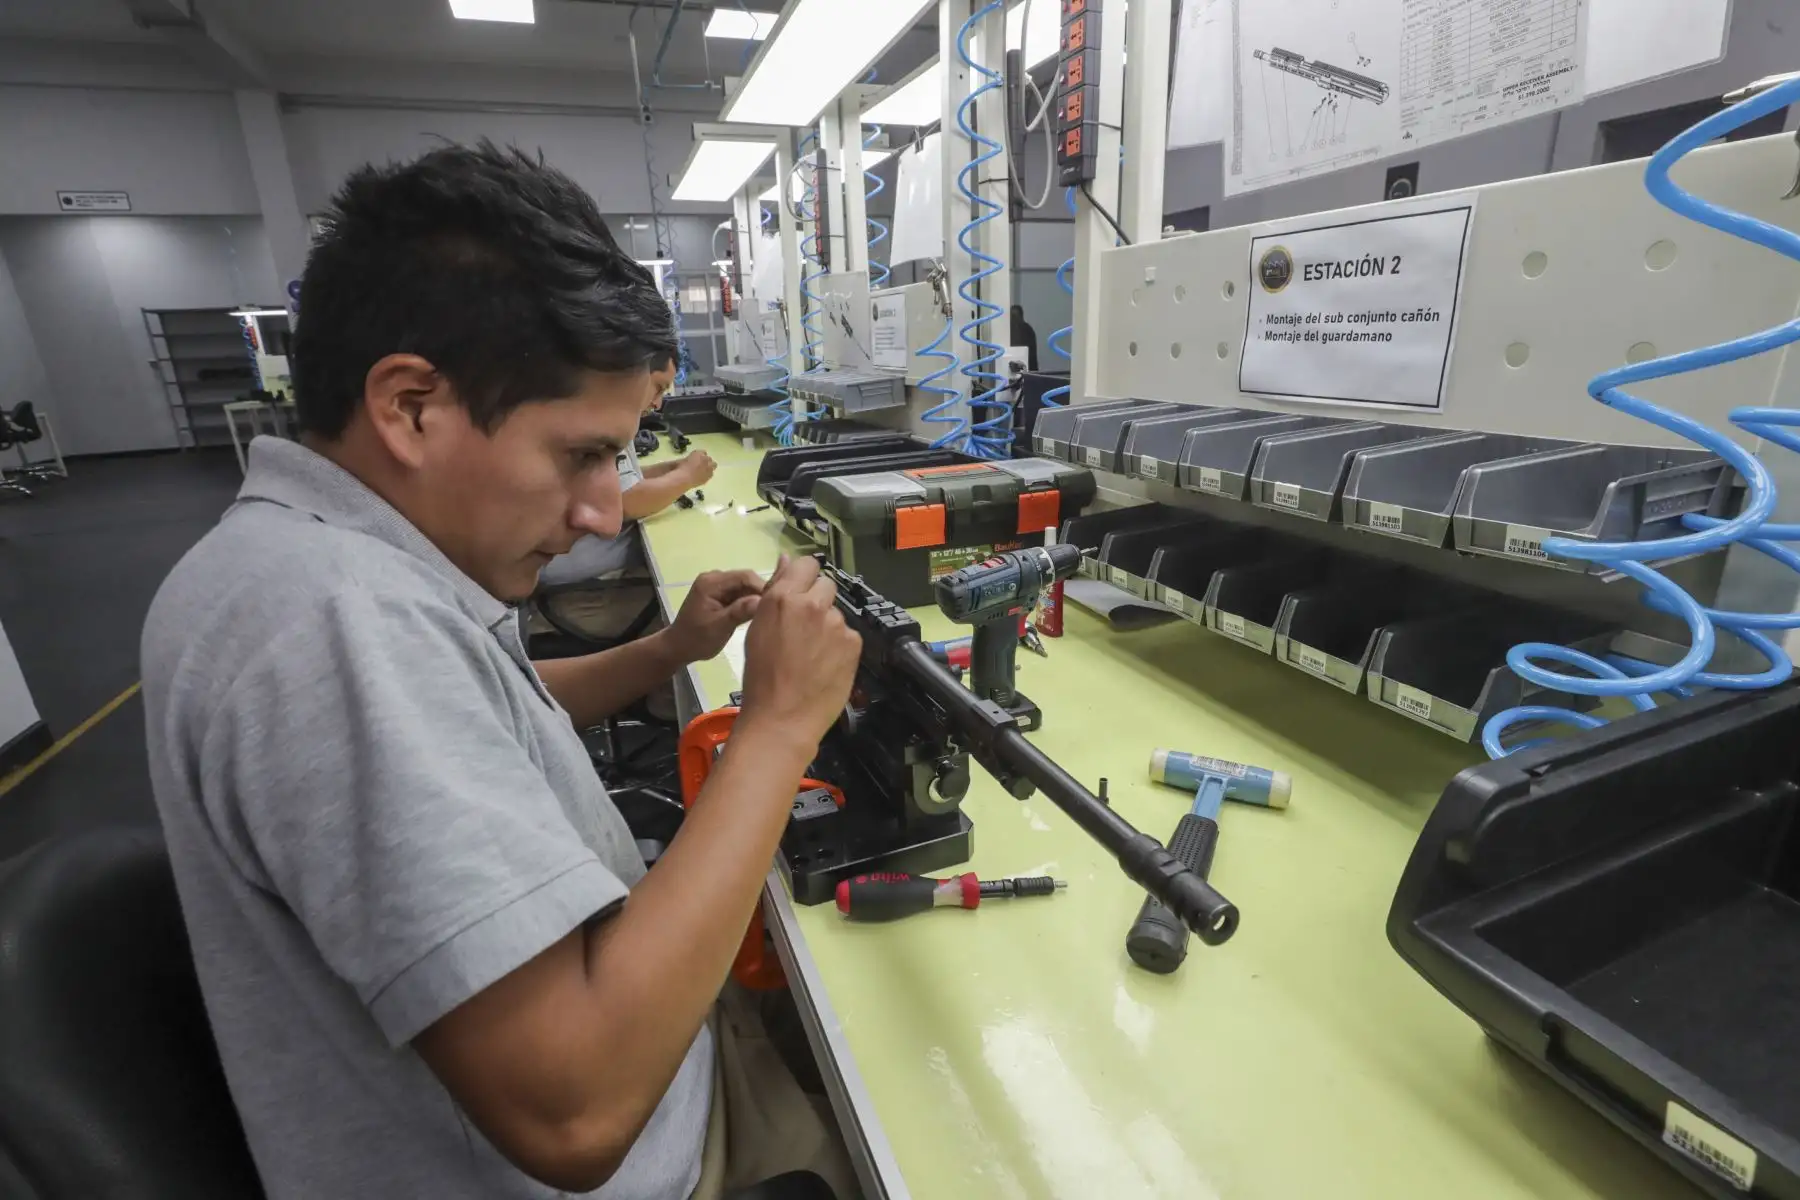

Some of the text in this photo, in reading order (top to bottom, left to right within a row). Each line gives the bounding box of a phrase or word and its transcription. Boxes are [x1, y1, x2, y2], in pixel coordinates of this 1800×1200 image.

[1519, 74, 1545, 88] RECEIVER
[1545, 65, 1574, 79] ASSEMBLY
[1303, 253, 1401, 282] ESTACIÓN 2
[1266, 307, 1440, 326] Montaje del sub conjunto cañón
[1264, 330, 1392, 344] Montaje del guardamano
